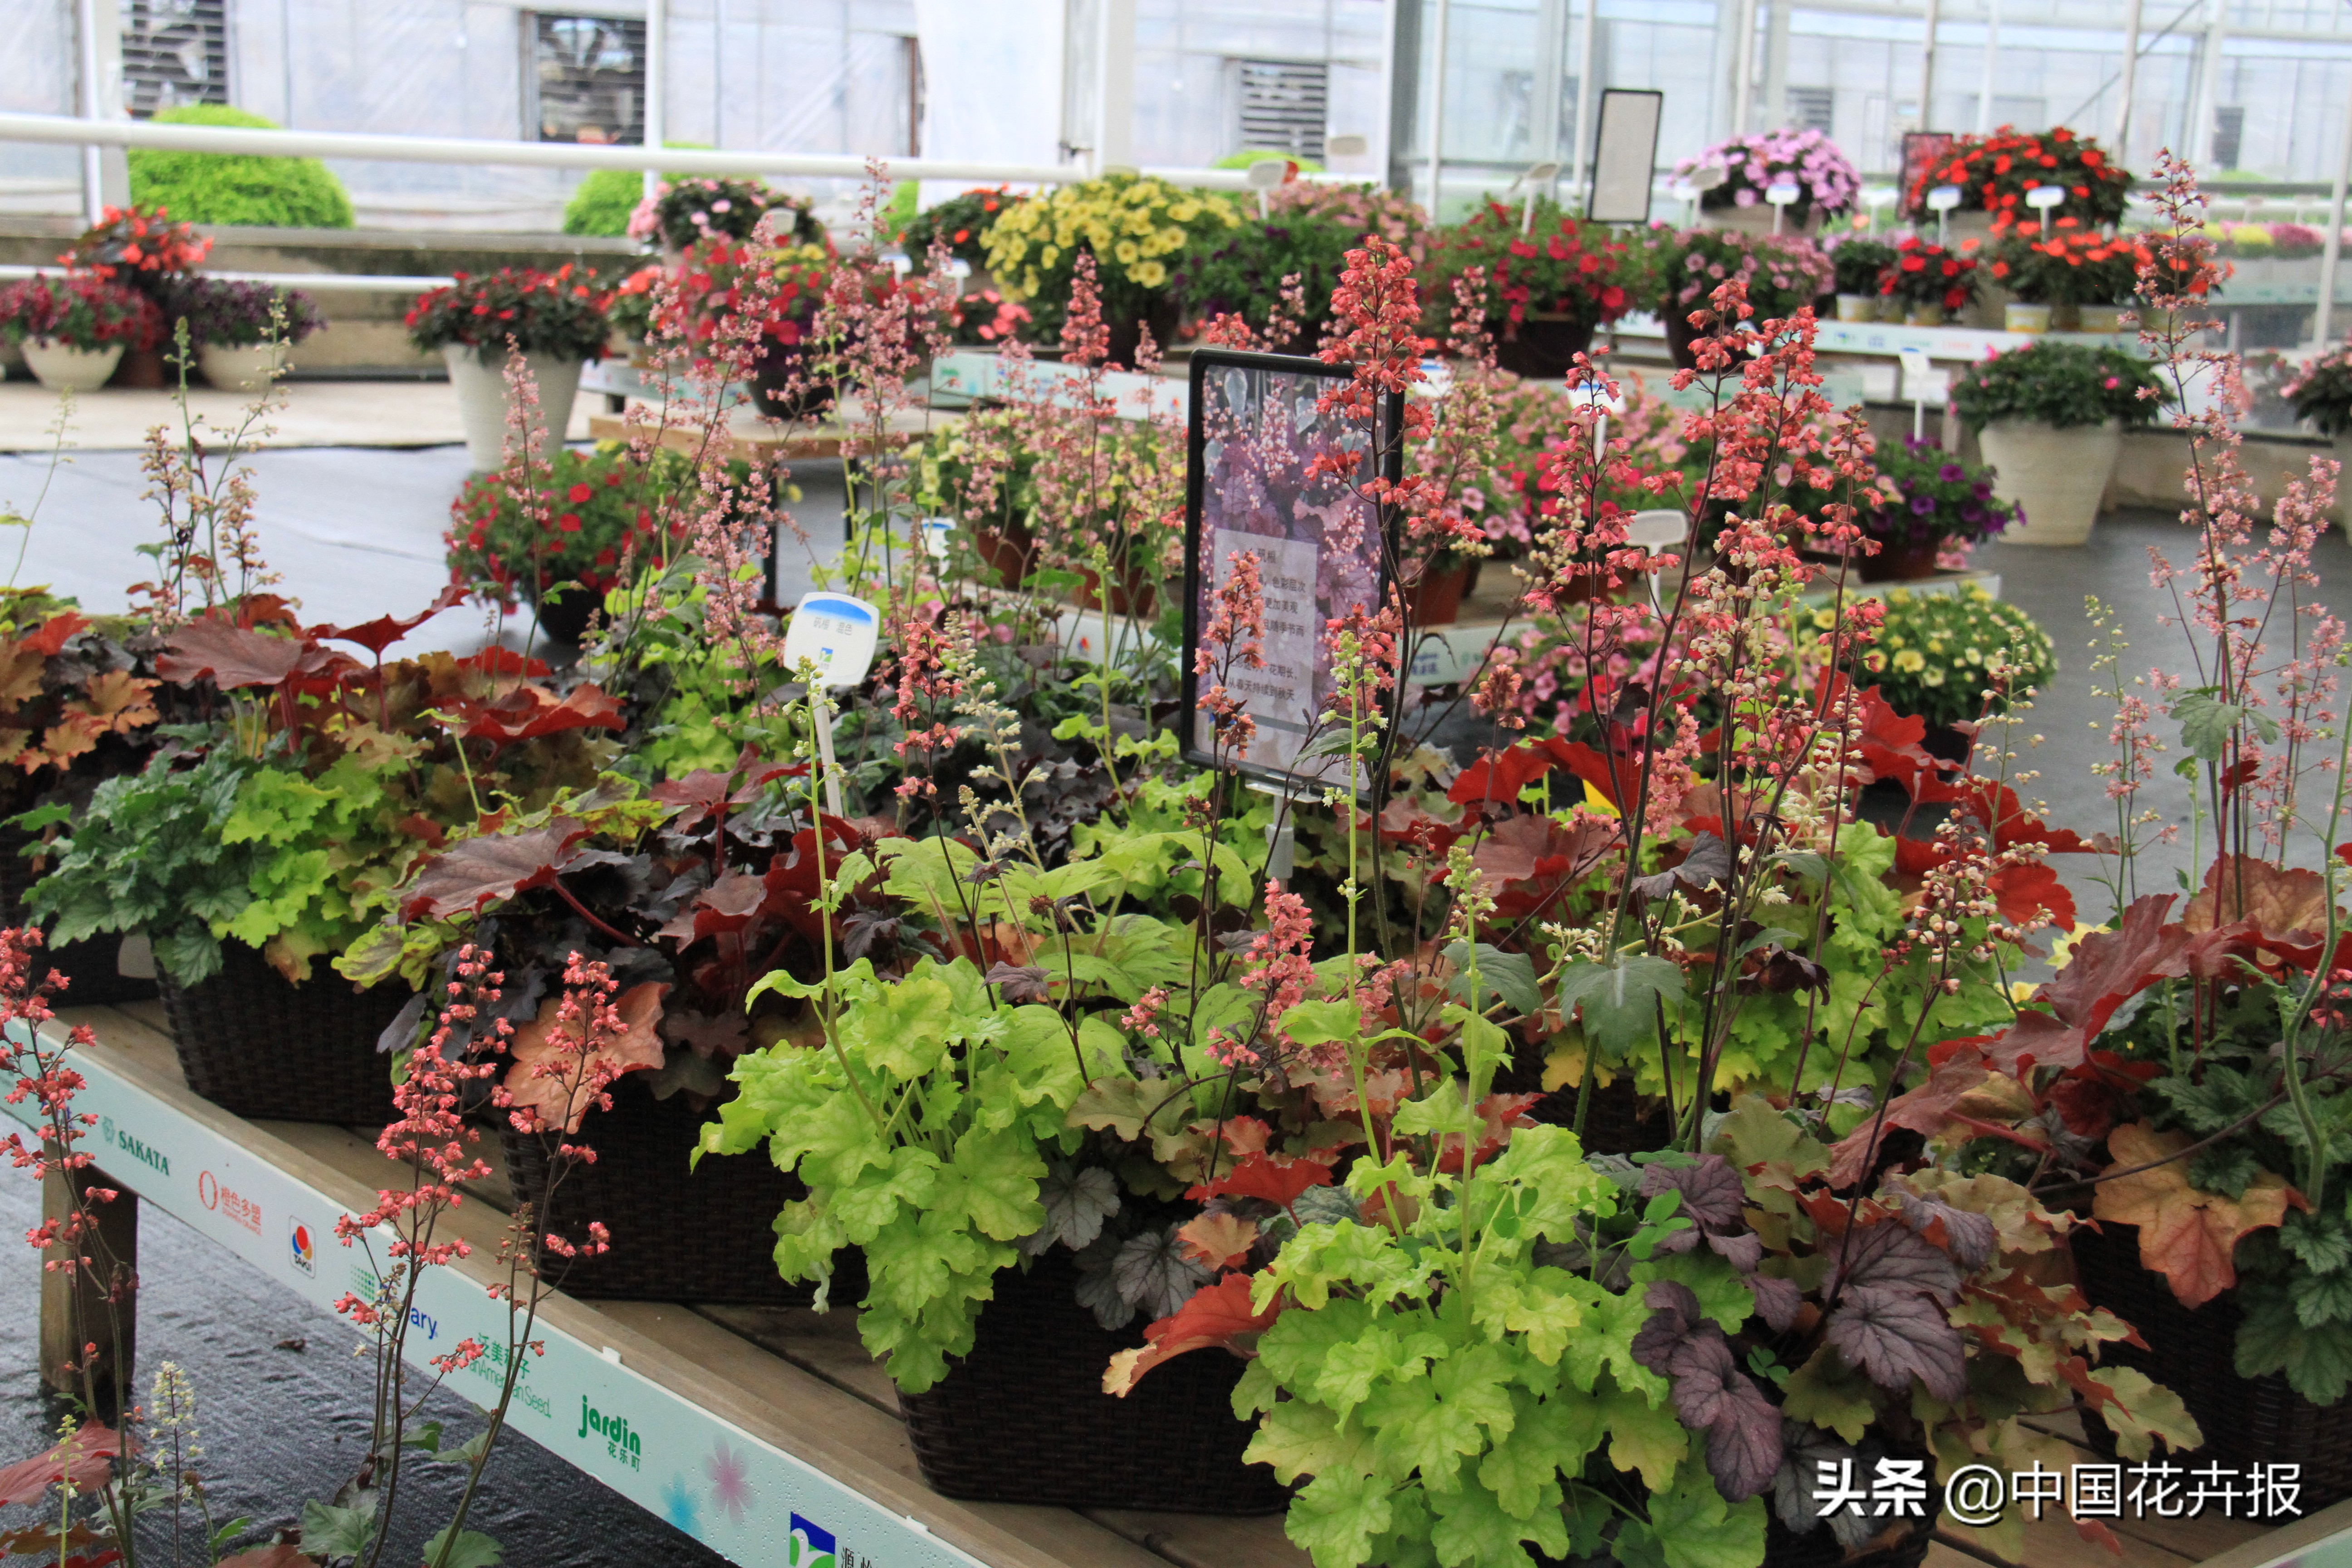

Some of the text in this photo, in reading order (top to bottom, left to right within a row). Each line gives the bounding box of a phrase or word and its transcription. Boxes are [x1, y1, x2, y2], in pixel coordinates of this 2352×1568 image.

[119, 1130, 169, 1176] SAKATA
[578, 1394, 640, 1456] jardin
[608, 1441, 640, 1472] 花乐町
